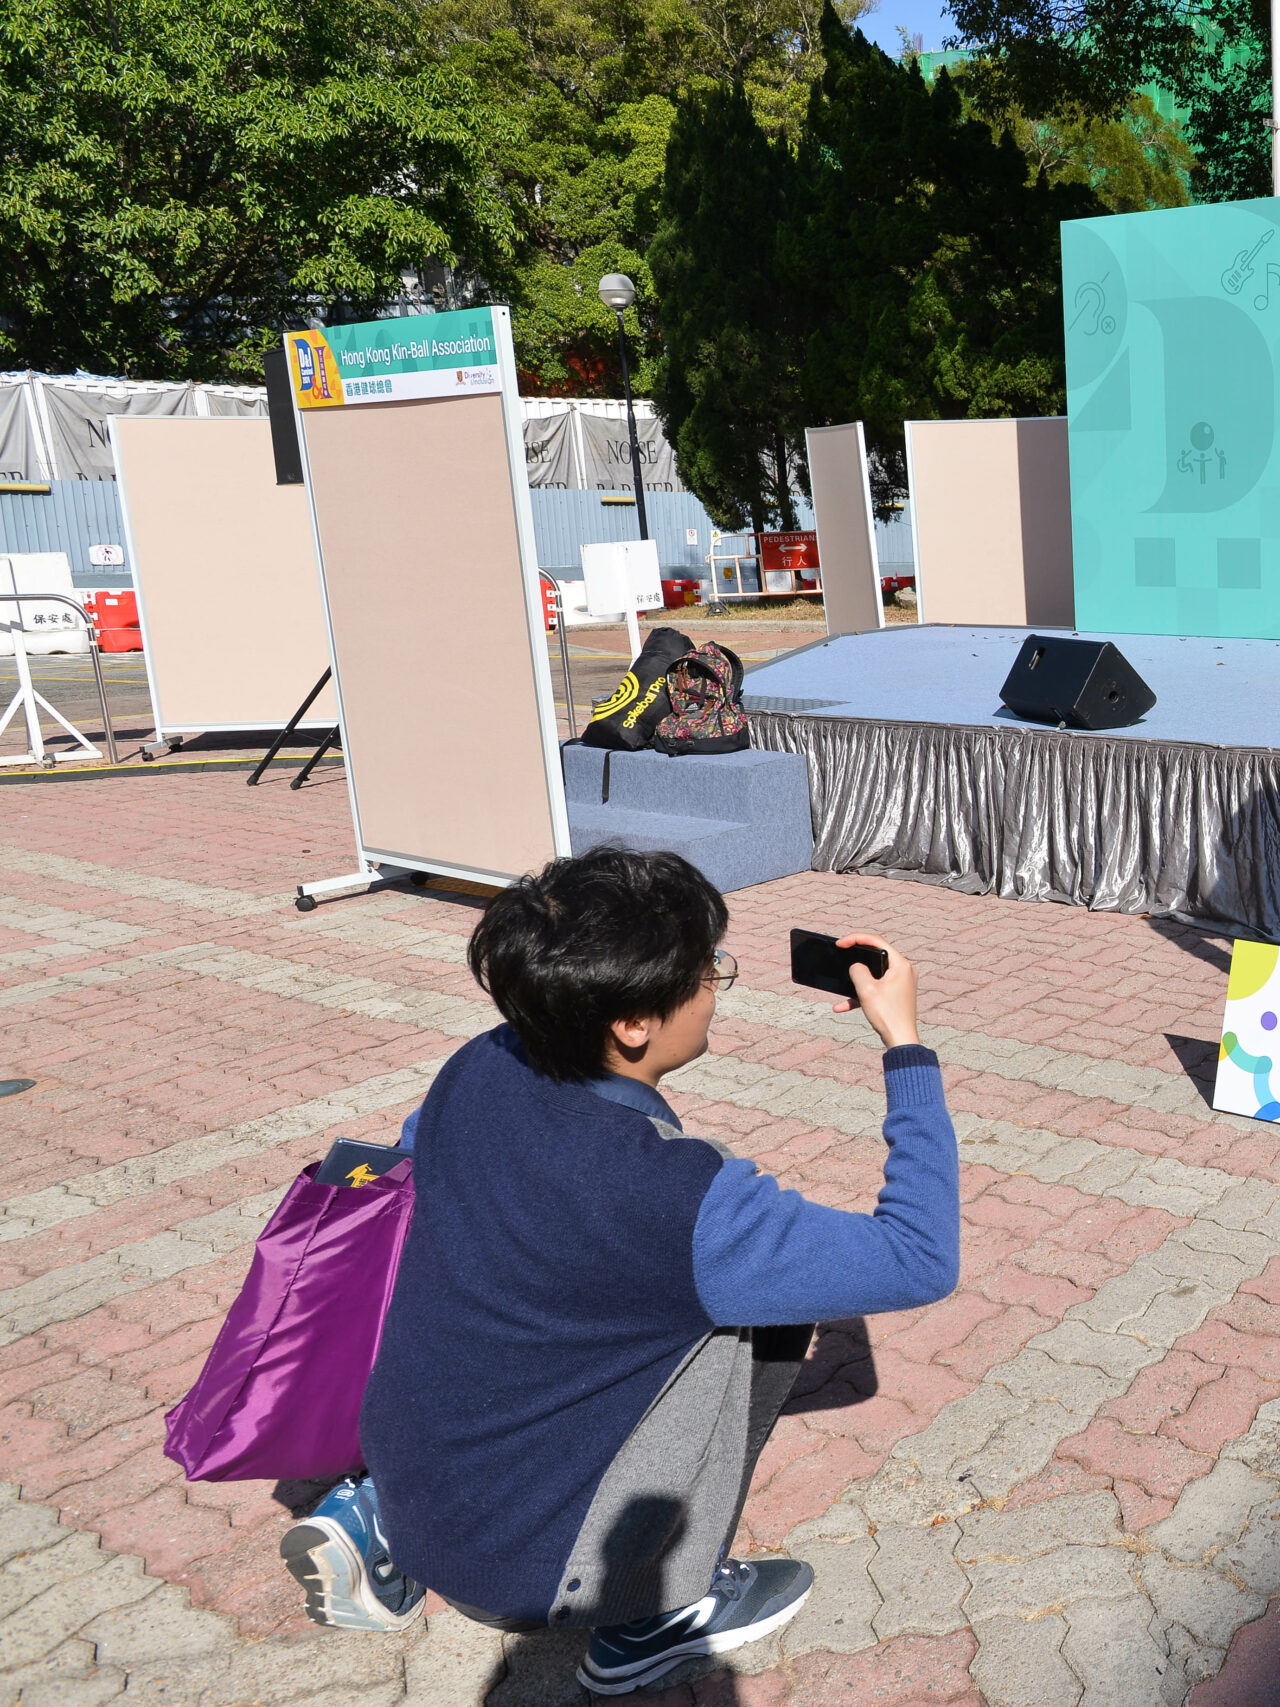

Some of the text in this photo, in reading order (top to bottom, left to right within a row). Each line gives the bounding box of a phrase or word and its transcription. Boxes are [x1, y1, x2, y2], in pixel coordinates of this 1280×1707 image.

[341, 334, 491, 369] Hong Kong Kin-Ball Association
[606, 440, 659, 464] NOSE
[763, 535, 817, 543] PEDESTRIAN
[782, 555, 808, 567] 行人
